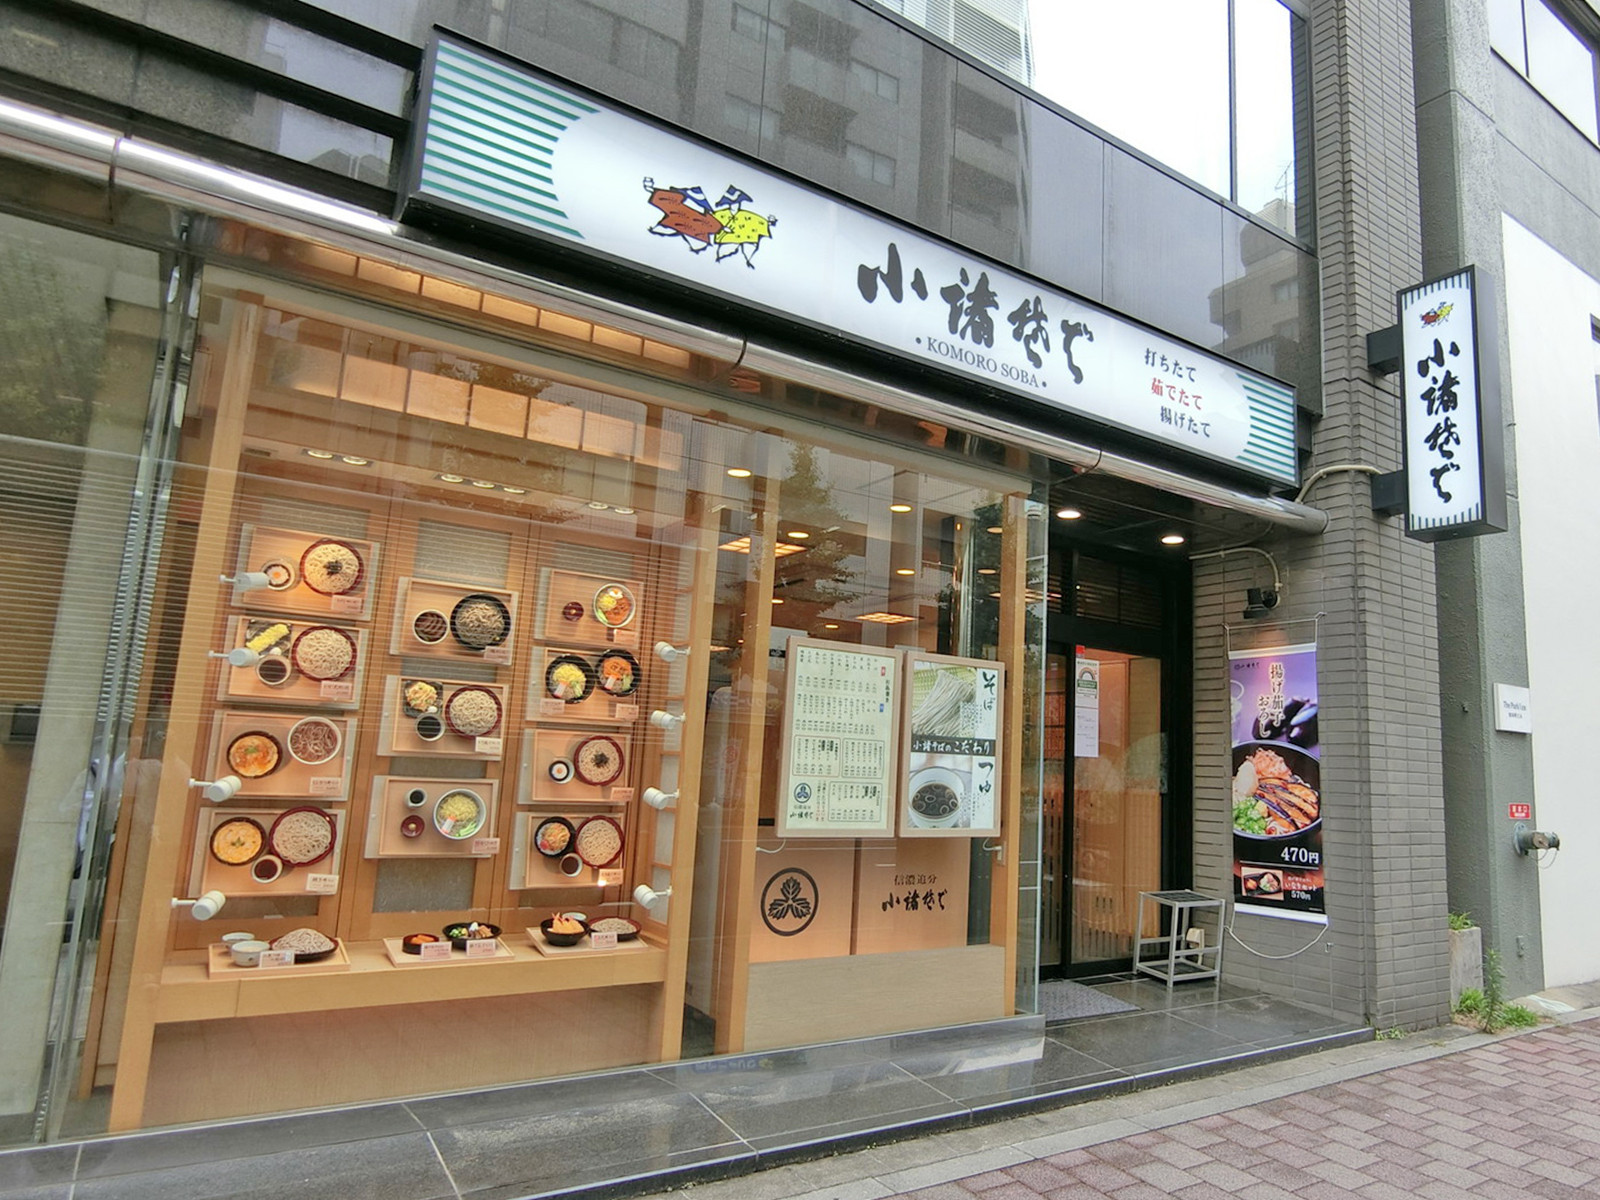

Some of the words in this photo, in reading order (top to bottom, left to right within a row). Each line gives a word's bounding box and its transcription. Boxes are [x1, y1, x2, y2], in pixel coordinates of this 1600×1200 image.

[927, 336, 998, 373] KOMORO
[1000, 362, 1039, 389] SOBA
[1144, 347, 1197, 383] 打ちたて
[1150, 377, 1203, 411] 茹でたて
[1159, 406, 1212, 439] 揚げたて
[982, 671, 996, 711] そば
[1269, 663, 1285, 726] 揚げ茄子
[1259, 695, 1271, 738] おろし
[978, 762, 994, 793] つゆ
[1281, 846, 1319, 864] 470円
[894, 874, 937, 886] 信濃追分
